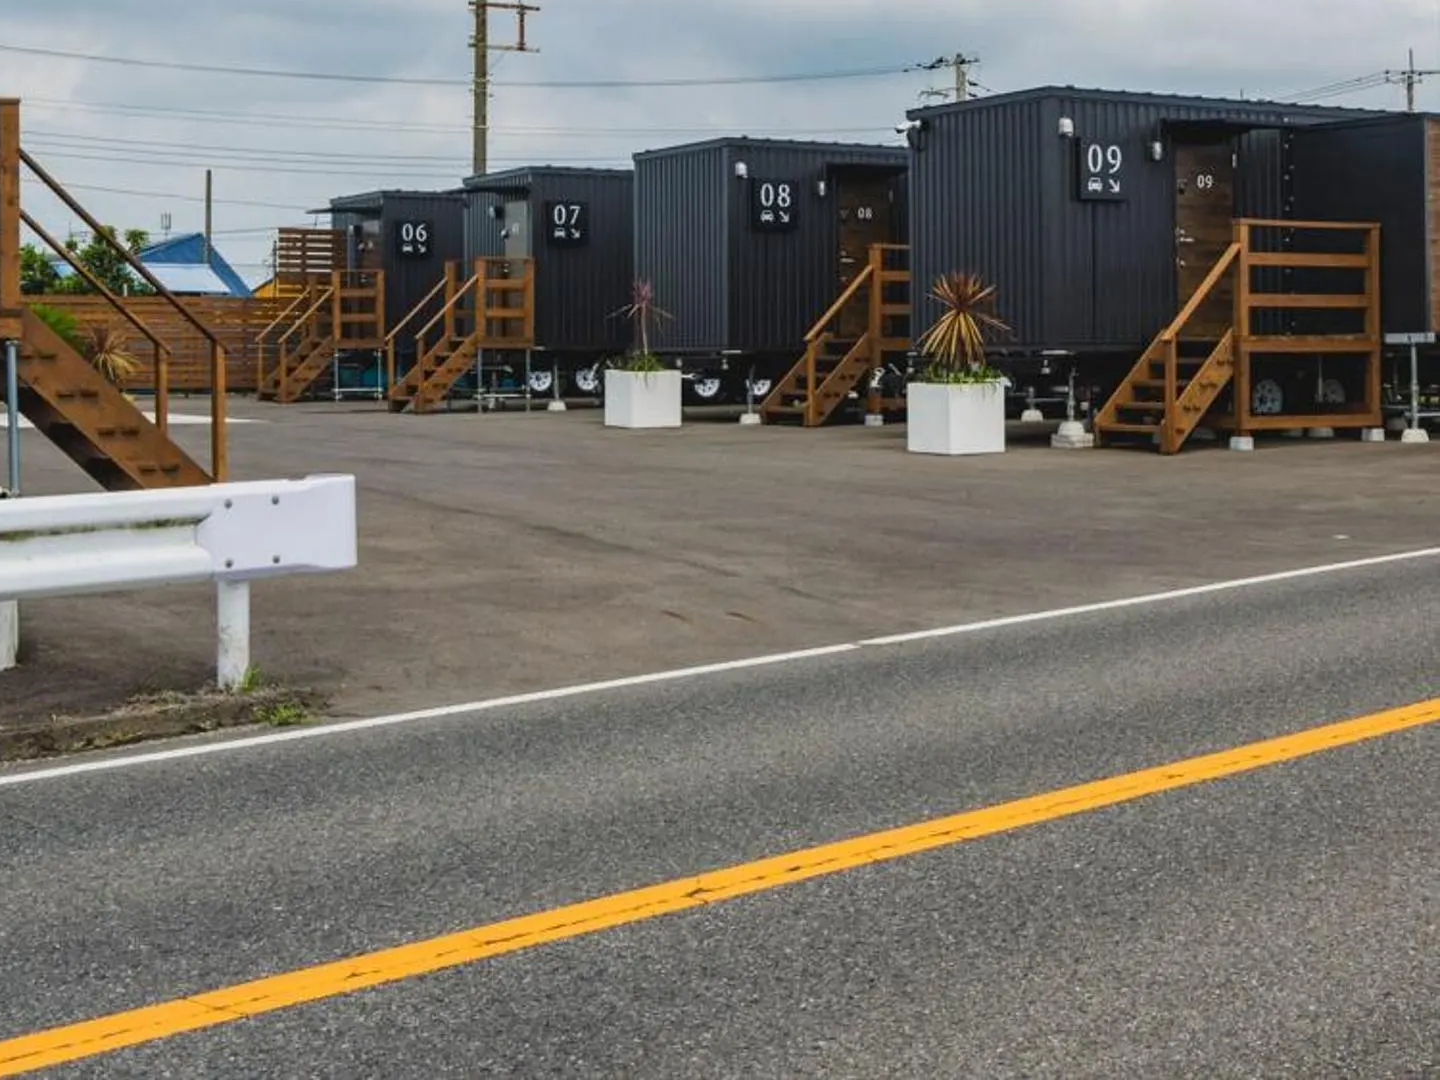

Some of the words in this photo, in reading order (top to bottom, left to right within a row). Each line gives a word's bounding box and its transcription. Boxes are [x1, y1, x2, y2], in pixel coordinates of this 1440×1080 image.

[1087, 144, 1122, 174] 09
[1196, 174, 1213, 189] 09
[760, 182, 791, 208] 08
[554, 204, 581, 225] 07
[402, 223, 427, 242] 06
